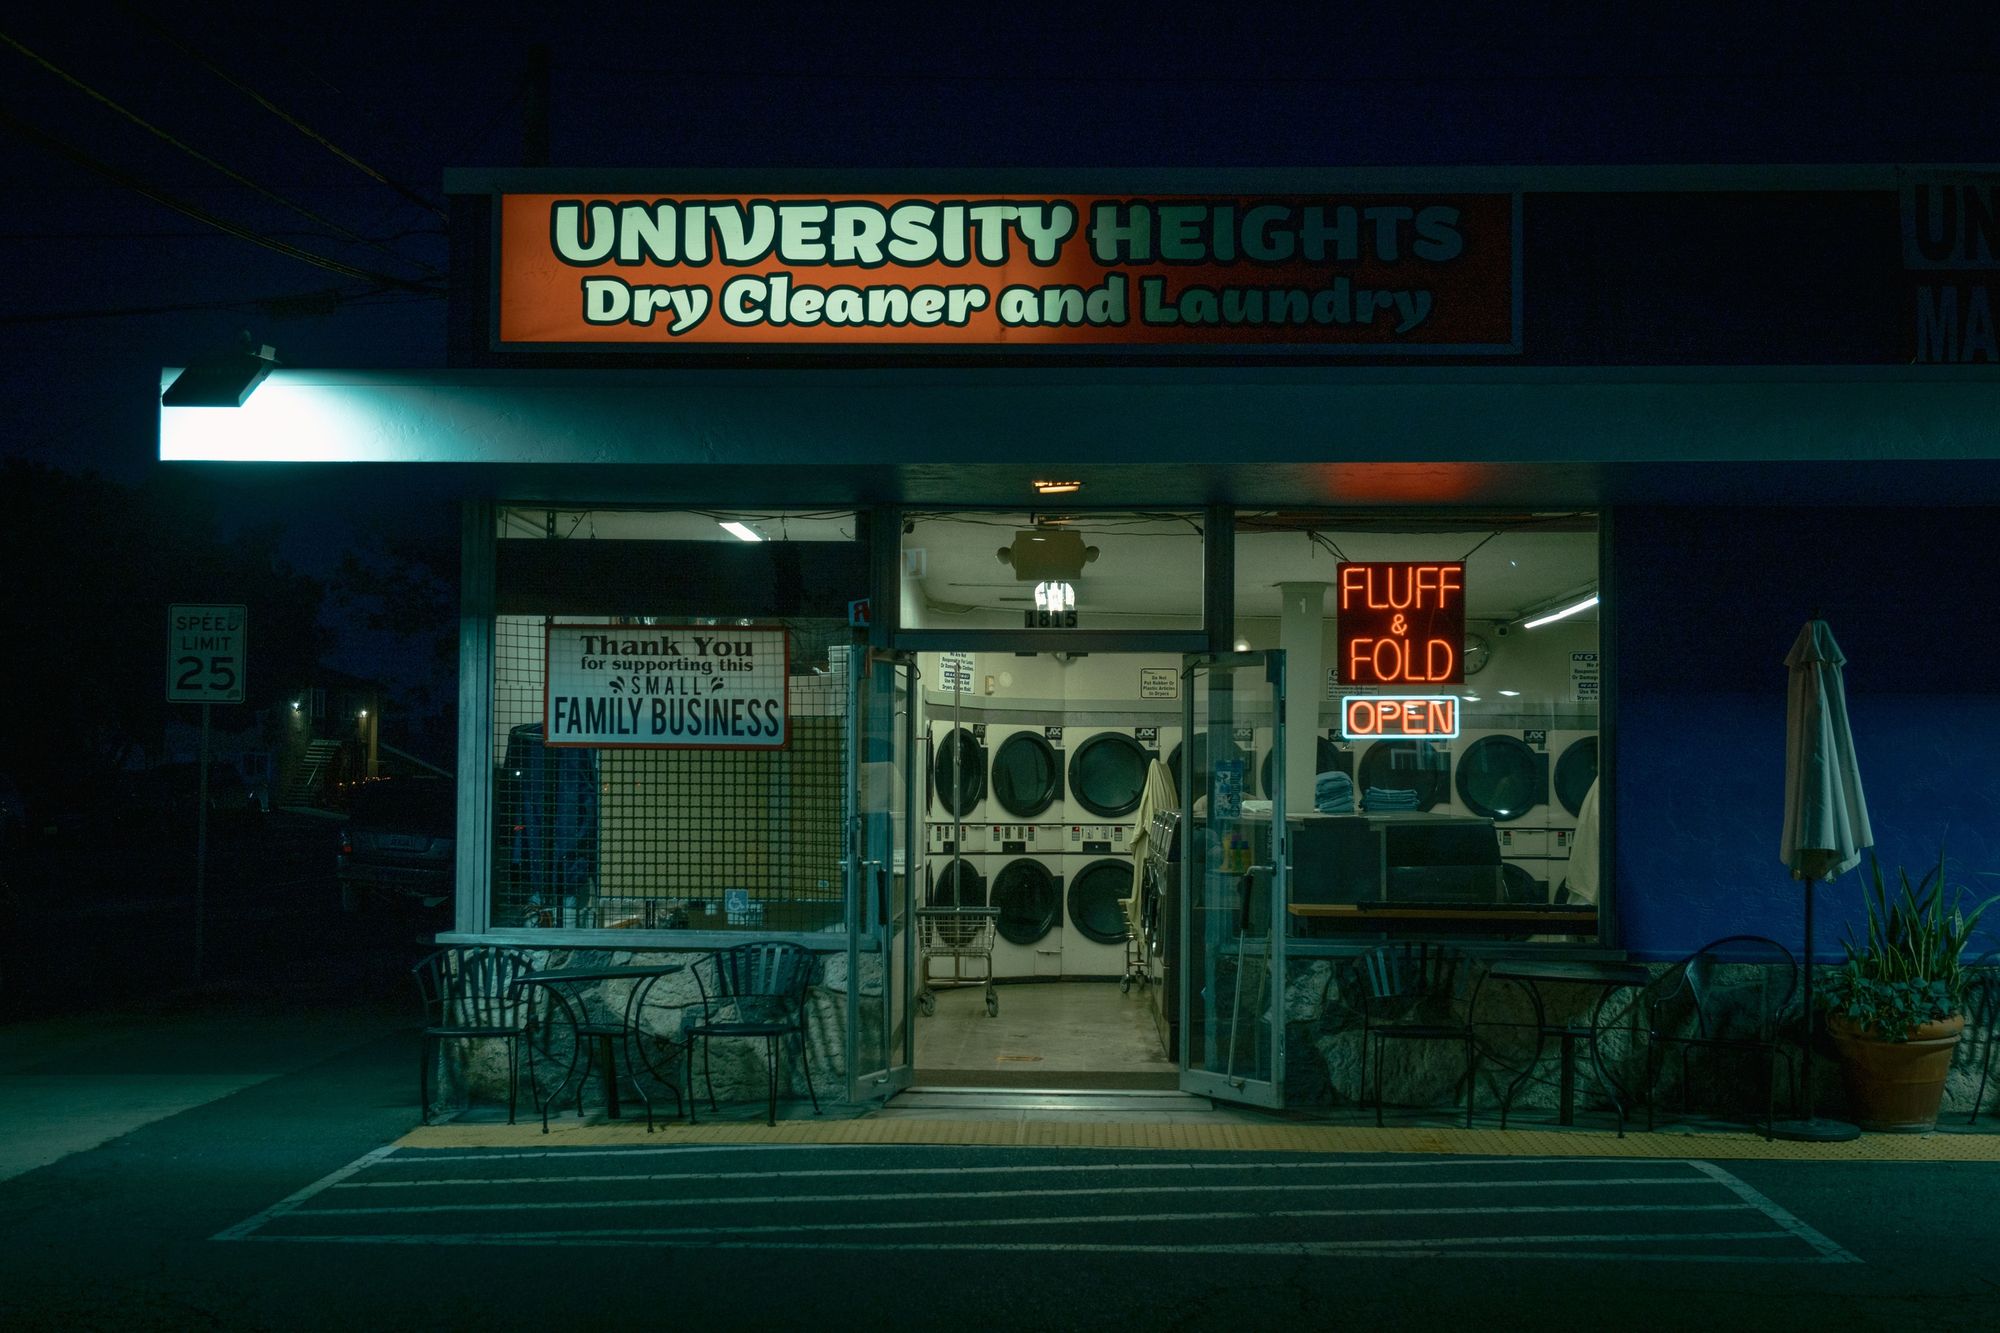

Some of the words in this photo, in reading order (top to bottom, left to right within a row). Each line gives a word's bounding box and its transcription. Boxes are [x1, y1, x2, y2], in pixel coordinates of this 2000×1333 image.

[555, 203, 1074, 264] UNIVERSITY
[1090, 203, 1465, 264] HEIGHTS
[584, 277, 709, 333] Dry
[723, 275, 987, 325] Cleaner
[1000, 274, 1128, 325] and
[1141, 275, 1434, 334] Laundry
[1342, 566, 1462, 610] FLUFF
[1027, 610, 1078, 628] 1815
[1390, 613, 1408, 636] &
[182, 635, 232, 651] LIMIT
[579, 635, 681, 656] Thank
[693, 637, 754, 657] You
[1350, 637, 1454, 681] FOLD
[176, 655, 236, 691] 25
[581, 656, 607, 670] for
[612, 658, 713, 675] supporting
[719, 658, 754, 672] this
[631, 676, 702, 695] SMALL
[554, 696, 643, 735] FAMILY
[651, 697, 779, 737] BUSINESS
[1349, 700, 1454, 734] OPEN
